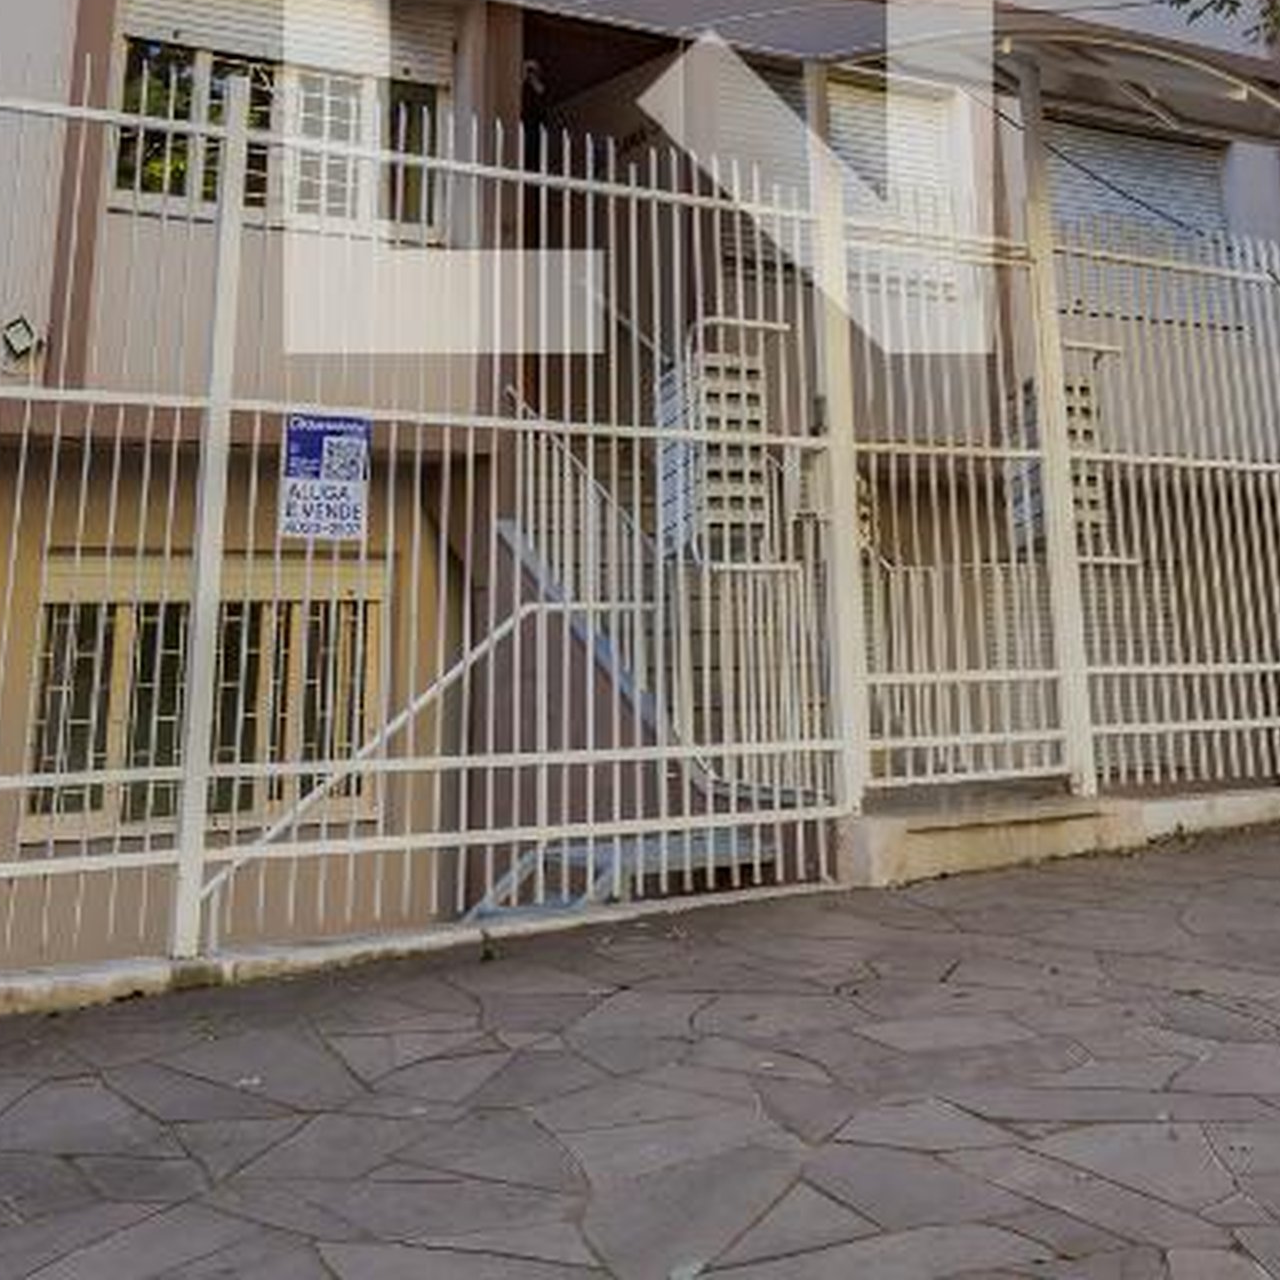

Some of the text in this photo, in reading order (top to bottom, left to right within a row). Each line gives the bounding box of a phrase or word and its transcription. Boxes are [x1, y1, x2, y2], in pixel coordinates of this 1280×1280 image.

[289, 482, 351, 501] ALUGA
[285, 501, 362, 521] E VENDE
